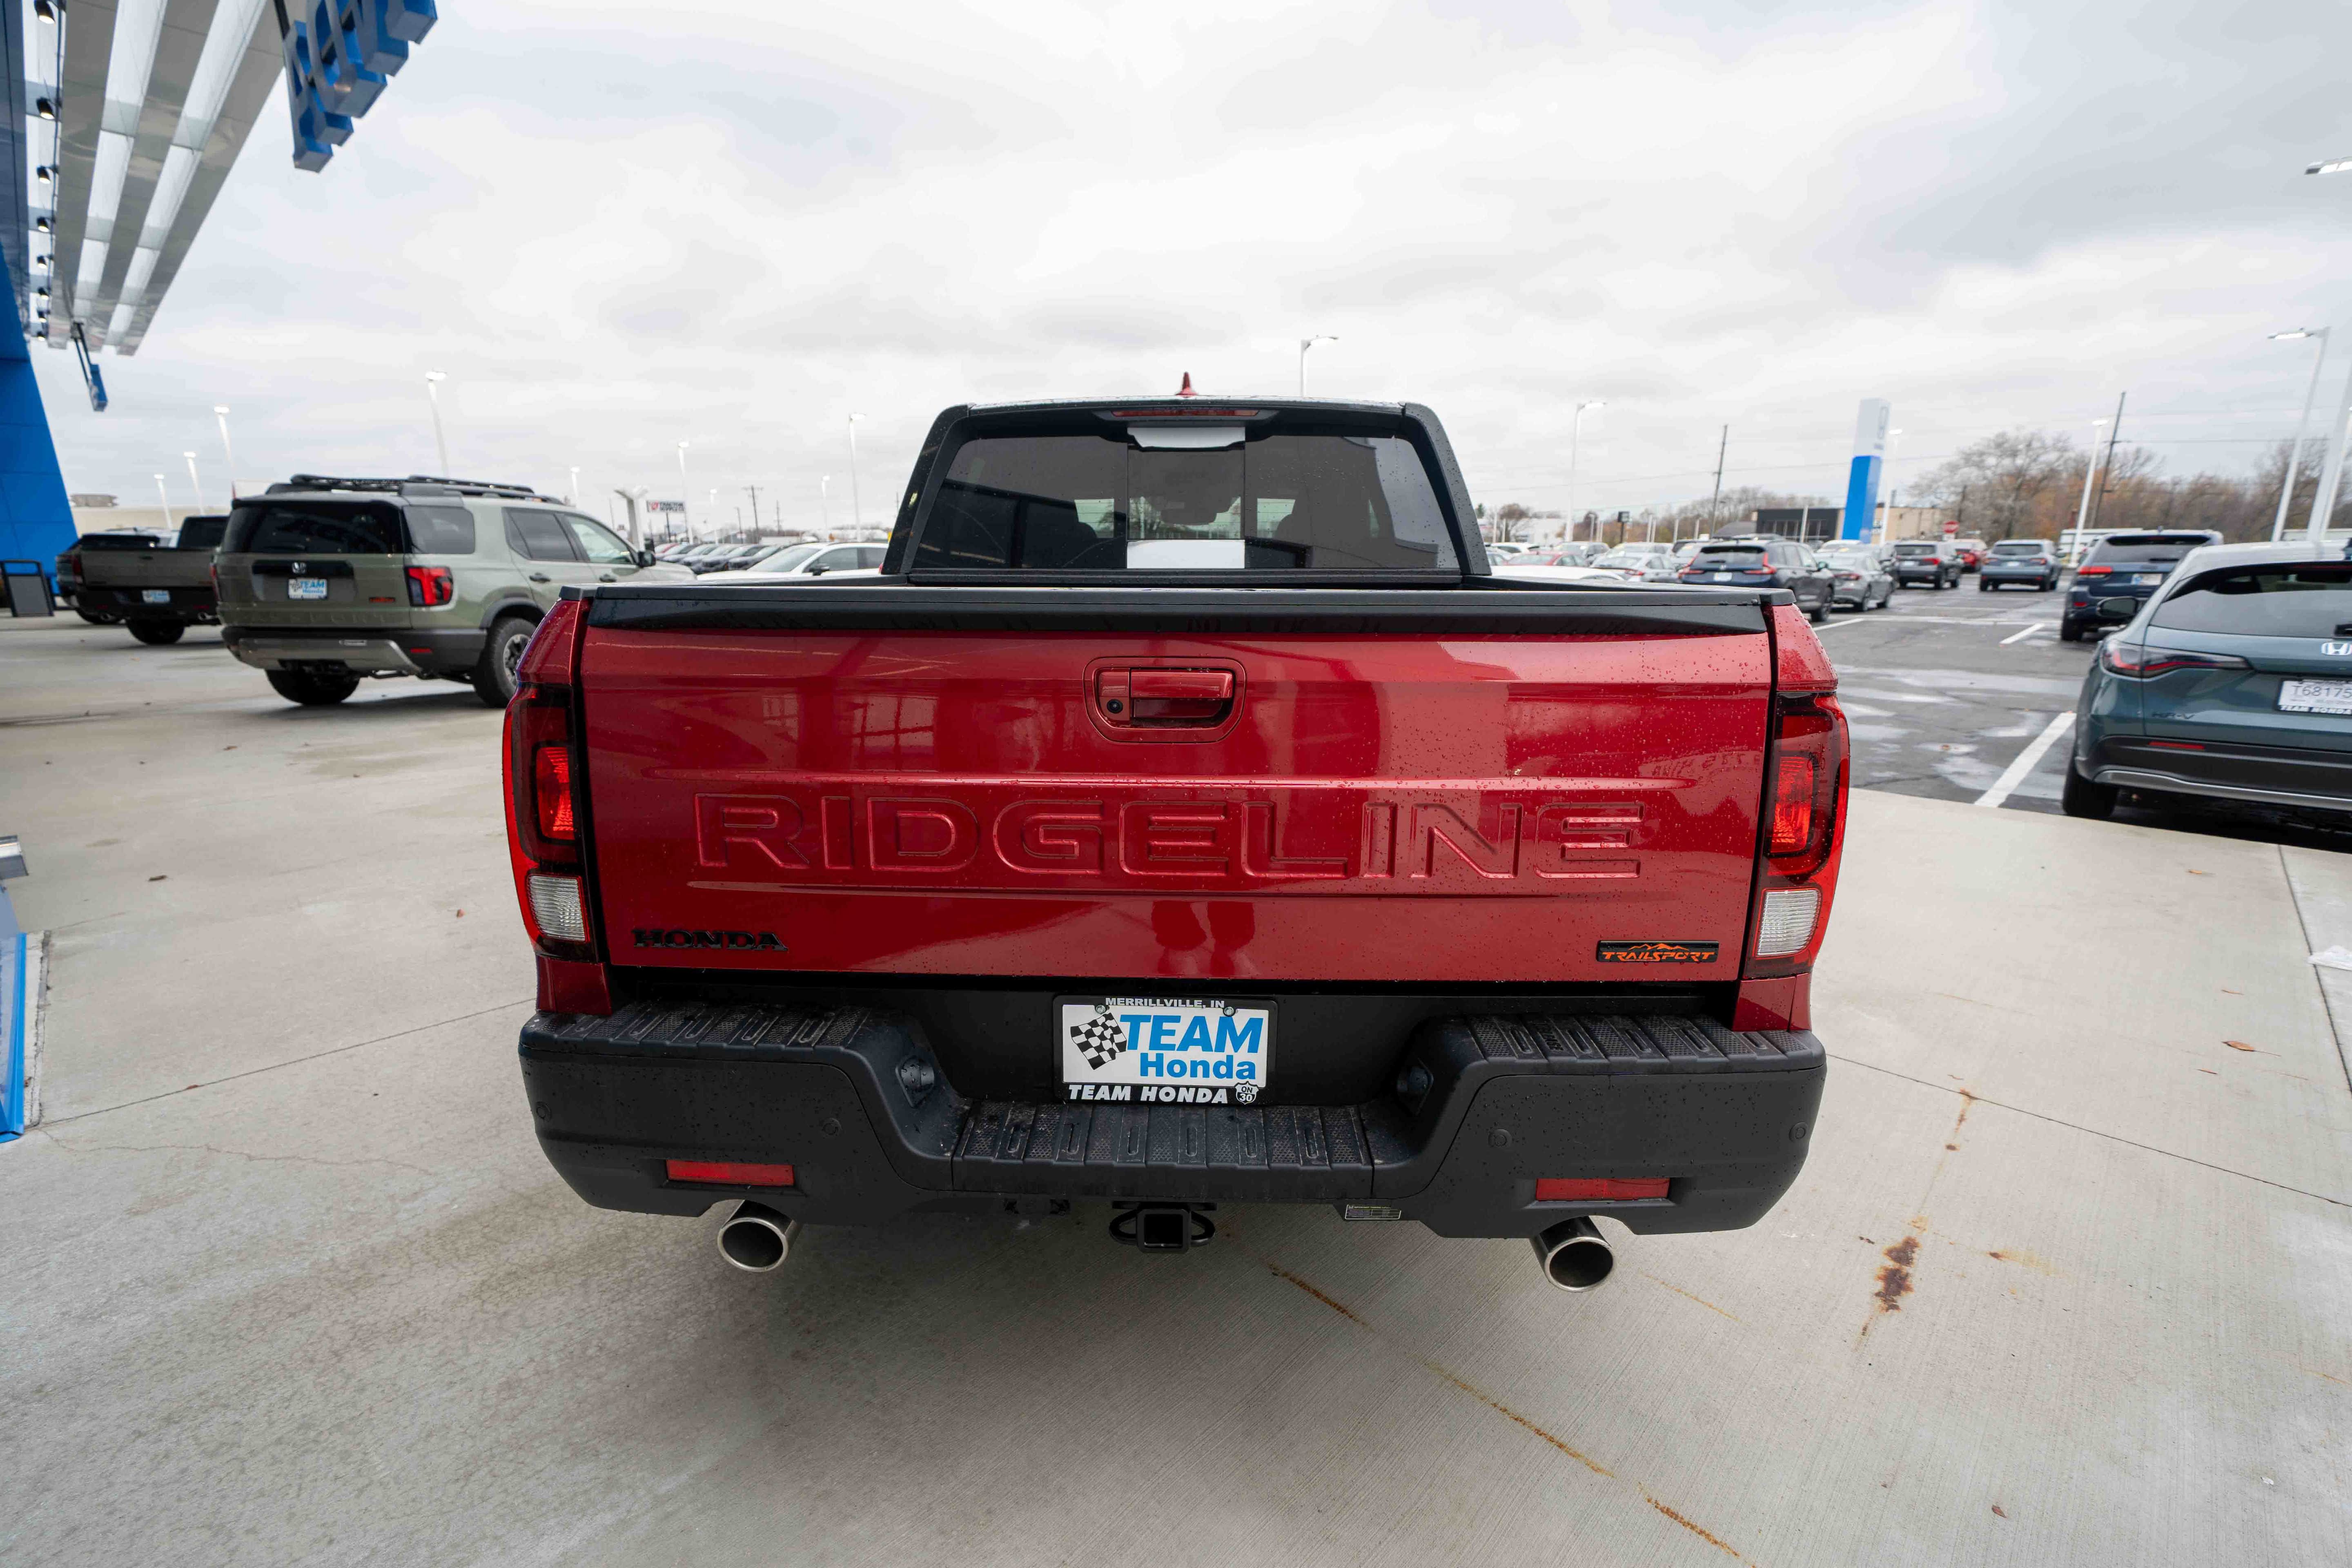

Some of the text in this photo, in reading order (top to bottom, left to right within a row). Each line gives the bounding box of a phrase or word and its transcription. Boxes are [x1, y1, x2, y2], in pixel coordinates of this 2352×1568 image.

[693, 791, 1645, 880] RIDGELINE
[632, 929, 788, 951] HONDA
[1602, 951, 1715, 962] TRAILSPORT
[1105, 997, 1225, 1009] MERRILLVILLE, IN
[1120, 1014, 1264, 1054] TEAM
[1140, 1053, 1256, 1080] Honda
[1069, 1084, 1228, 1104] TEAM HONDA
[1239, 1093, 1252, 1102] 30
